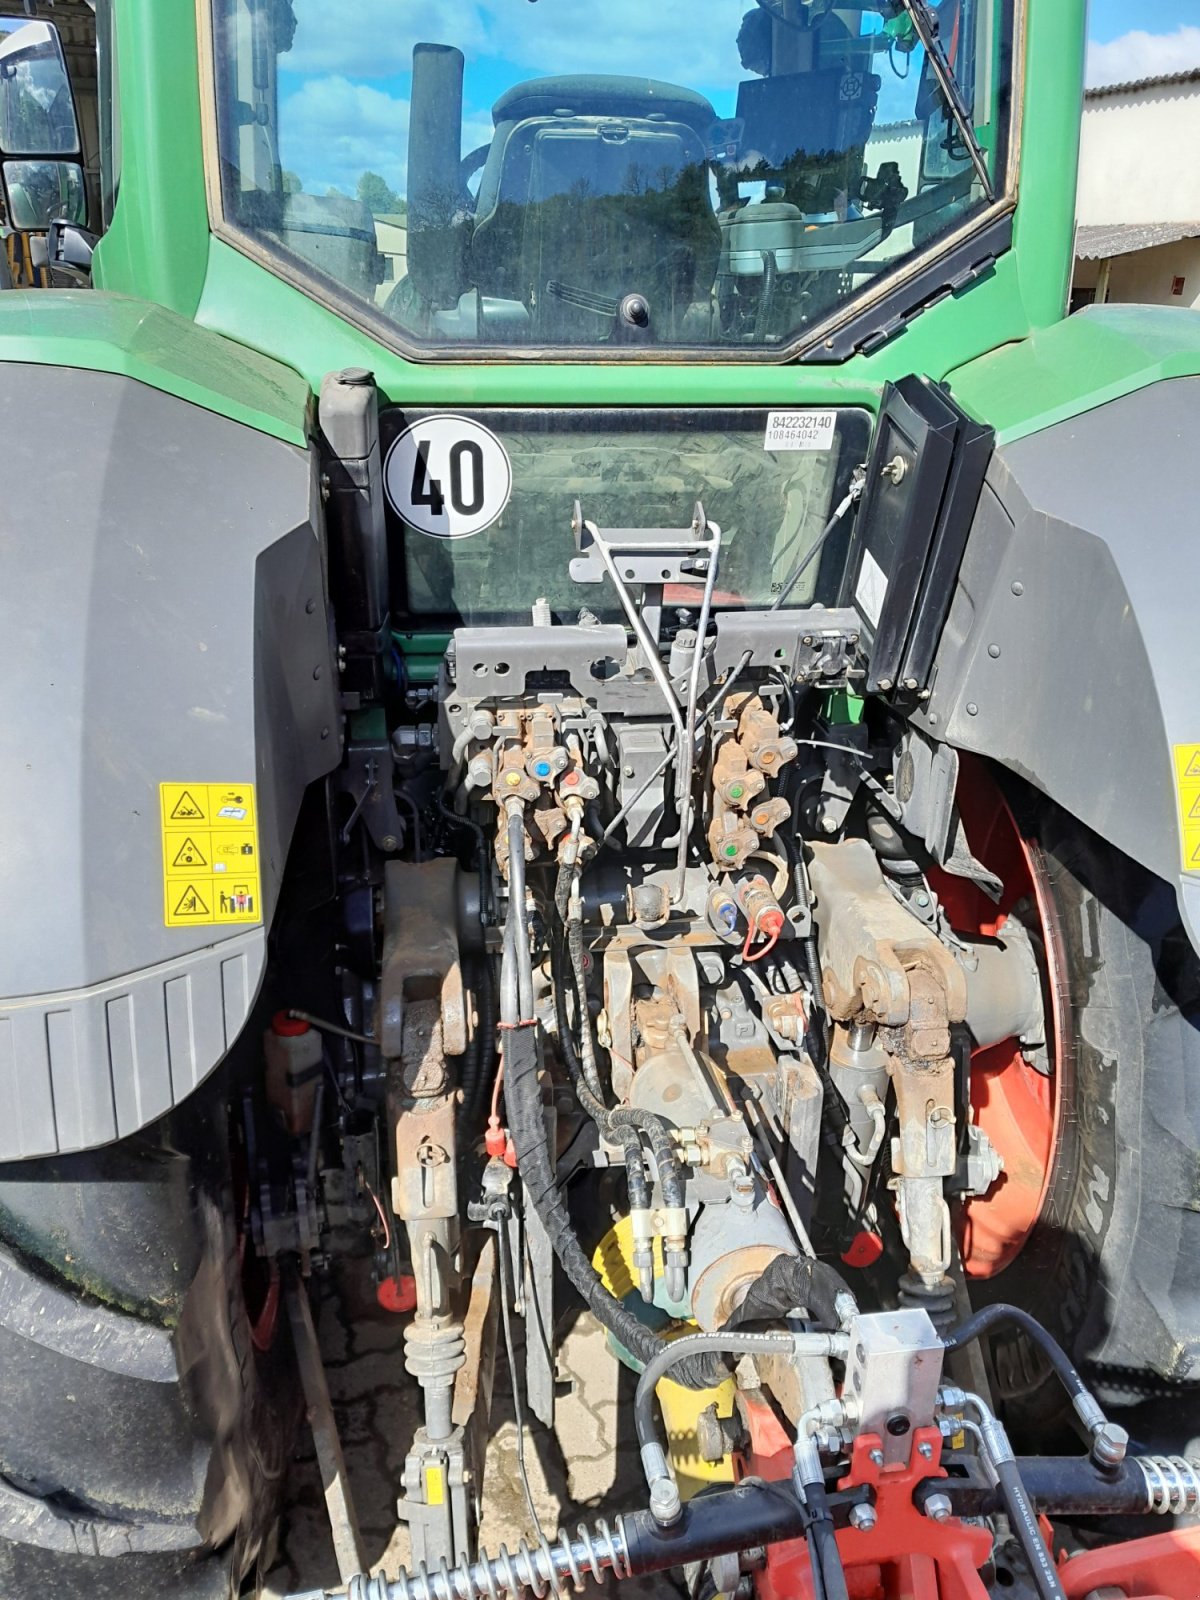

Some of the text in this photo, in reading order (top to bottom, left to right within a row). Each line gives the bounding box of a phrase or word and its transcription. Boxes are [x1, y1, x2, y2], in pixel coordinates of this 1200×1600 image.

[768, 429, 819, 440] 108464042
[772, 416, 832, 429] 842232140
[411, 439, 484, 516] 40
[1012, 1486, 1036, 1536] HYDRAULIC
[1032, 1537, 1042, 1551] EN
